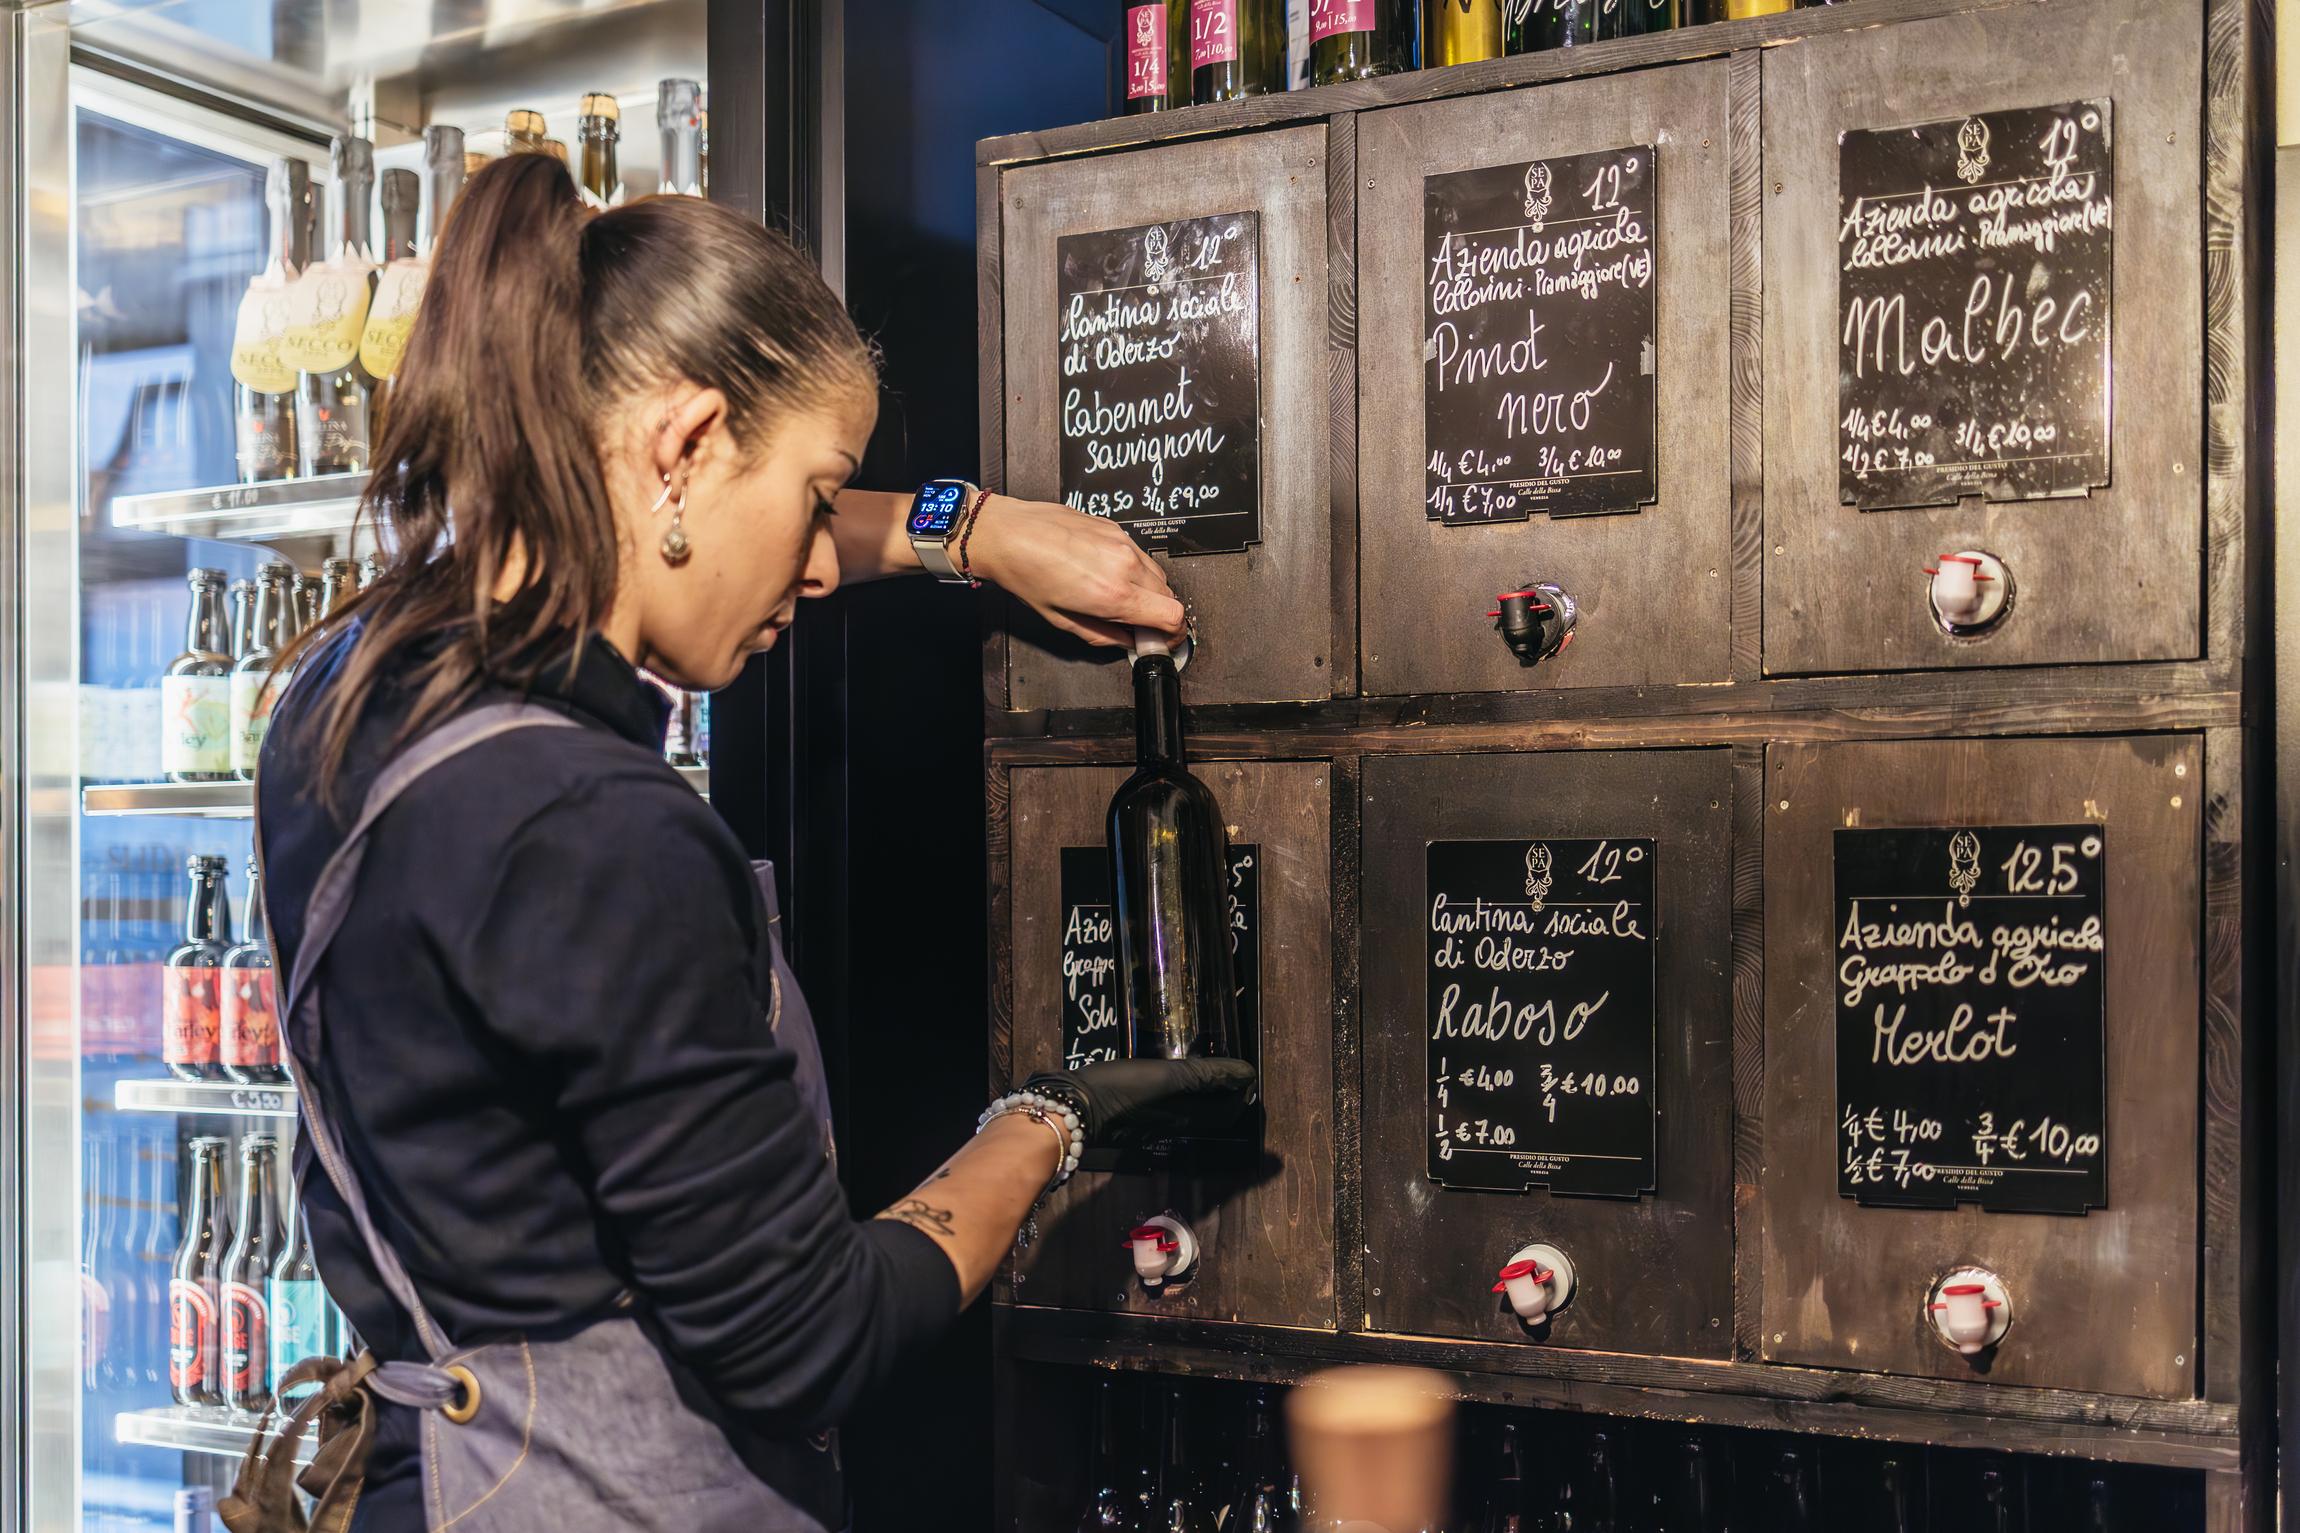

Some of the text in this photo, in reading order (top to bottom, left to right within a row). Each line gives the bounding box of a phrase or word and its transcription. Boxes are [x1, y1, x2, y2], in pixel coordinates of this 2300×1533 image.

[1195, 10, 1228, 40] 1/2
[1134, 57, 1160, 77] 1/4
[1965, 123, 1981, 135] SE
[1965, 135, 1982, 147] PA
[2039, 110, 2100, 167] 12°
[1531, 167, 1545, 178] SE
[1531, 178, 1545, 188] PA
[1582, 157, 1638, 211] 12°
[1838, 160, 2096, 243] Azienda agricola
[1150, 230, 1162, 241] SE
[1150, 241, 1162, 251] PA
[1429, 206, 1648, 285] Azienda agricola
[1061, 272, 1245, 342] Cantina sociale
[288, 336, 353, 351] SECCO
[1843, 273, 2092, 379] Malbec
[1064, 331, 1181, 376] di Oderzo
[1433, 309, 1548, 391] Pinot
[1064, 366, 1193, 438] Cabernet
[1497, 361, 1614, 439] nero
[1841, 407, 1869, 442] 1/4
[1955, 418, 1986, 458] 3/4
[1427, 449, 1452, 484] 1/4
[1538, 445, 1565, 477] 3/4
[1842, 444, 1868, 480] 1/2
[1141, 486, 1165, 516] 3/4
[1426, 486, 1456, 516] 1/2
[1509, 481, 1536, 489] PRESIDIO
[1549, 478, 1570, 486] GUSTO
[1517, 488, 1532, 496] Calle
[1532, 848, 1546, 858] SE
[1957, 835, 1972, 847] SE
[1957, 847, 1973, 858] PA
[1532, 858, 1546, 869] PA
[1577, 840, 1644, 884] 12°
[2001, 835, 2101, 896] 12,5°
[1064, 906, 1112, 946] Azie
[1431, 892, 1646, 940] Cantina sociale
[1839, 900, 2104, 960] Azienda agricola
[1434, 936, 1575, 972] di Oderzo
[1839, 950, 1975, 1008] Grappolo
[1432, 983, 1609, 1046] Raboso
[1872, 1002, 2017, 1066] Merlot
[1842, 1103, 1863, 1148] 1/4
[1971, 1111, 1998, 1166] 3/4
[1533, 1161, 1546, 1169] della
[1844, 1146, 1863, 1184] 1/2
